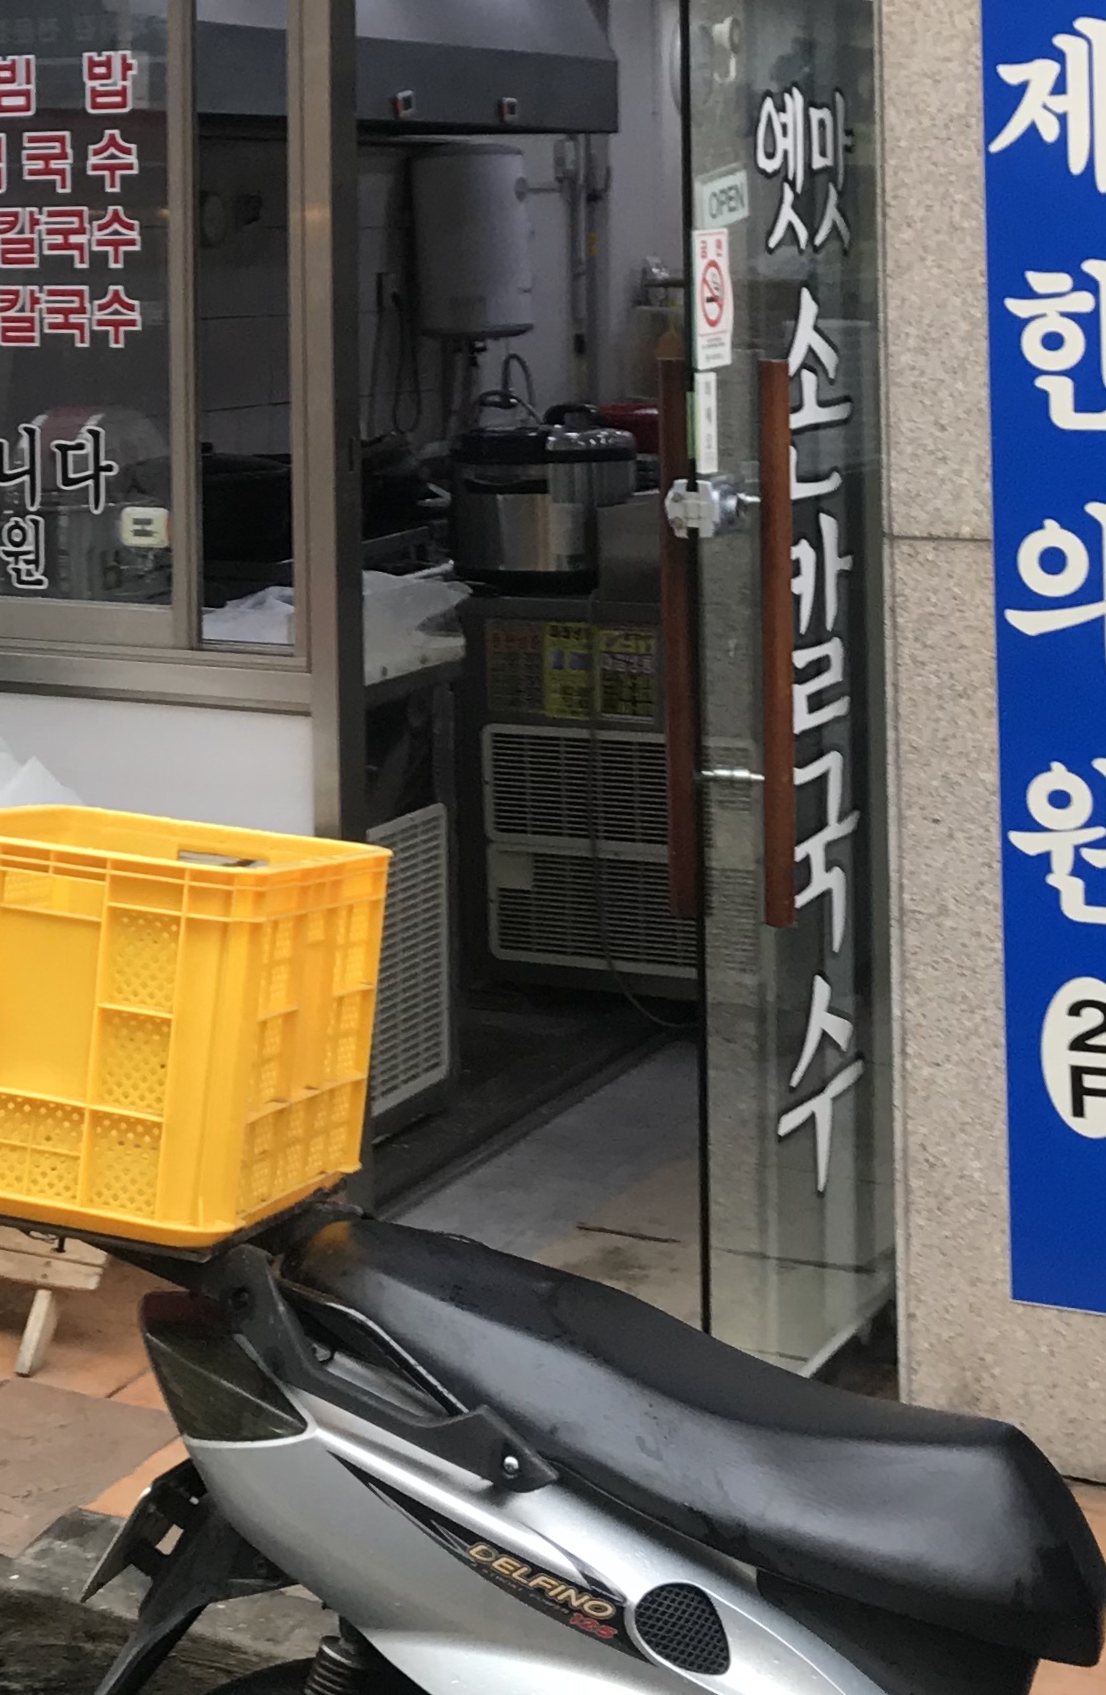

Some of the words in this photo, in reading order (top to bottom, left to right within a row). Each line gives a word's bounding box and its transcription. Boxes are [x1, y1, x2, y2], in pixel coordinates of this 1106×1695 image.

[754, 85, 854, 254] 옛맛
[776, 285, 863, 1196] 손칼국수
[466, 1541, 617, 1620] DELFINO
[569, 1612, 618, 1640] 125
